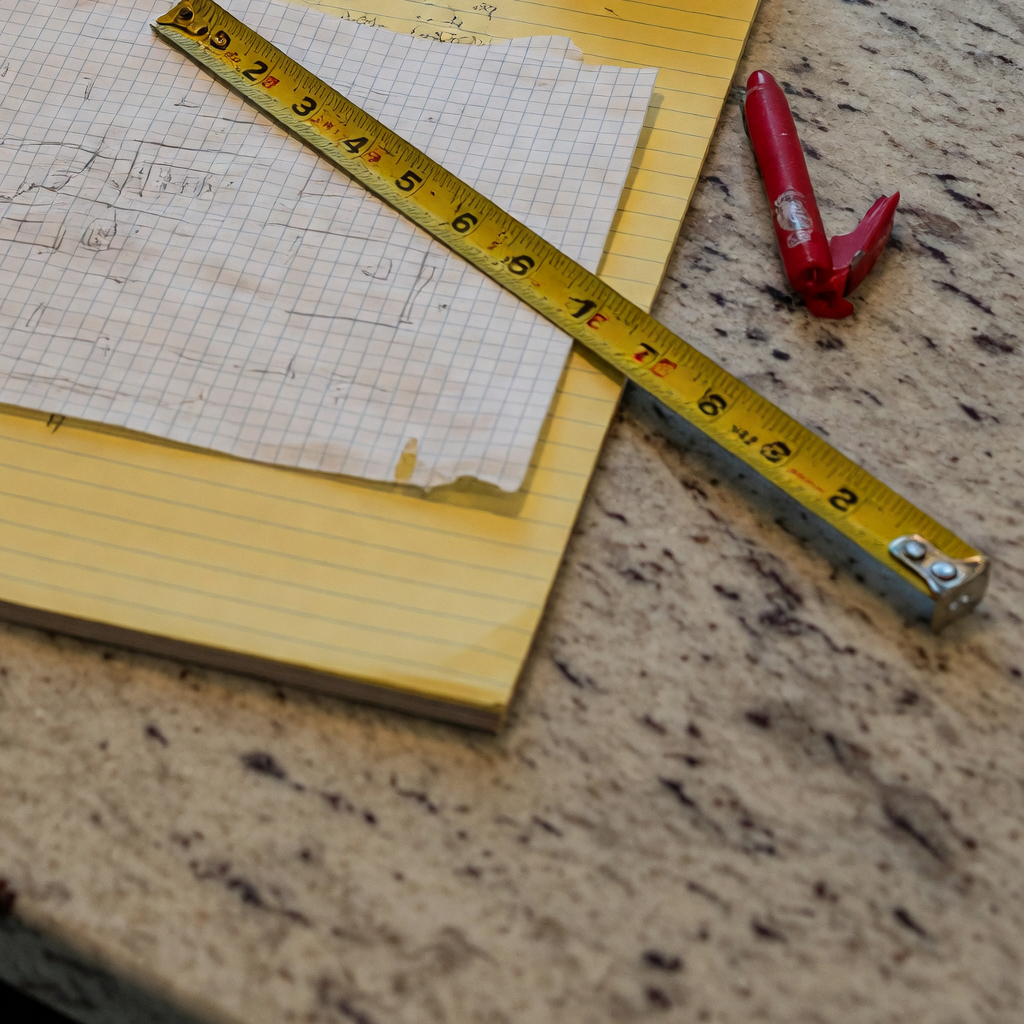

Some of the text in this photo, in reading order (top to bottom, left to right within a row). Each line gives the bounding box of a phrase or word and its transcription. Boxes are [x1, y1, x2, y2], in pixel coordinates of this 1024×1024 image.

[242, 60, 269, 82] 2
[291, 96, 318, 117] 3
[343, 136, 369, 154] 4
[395, 169, 423, 192] 5
[451, 212, 478, 234] 6
